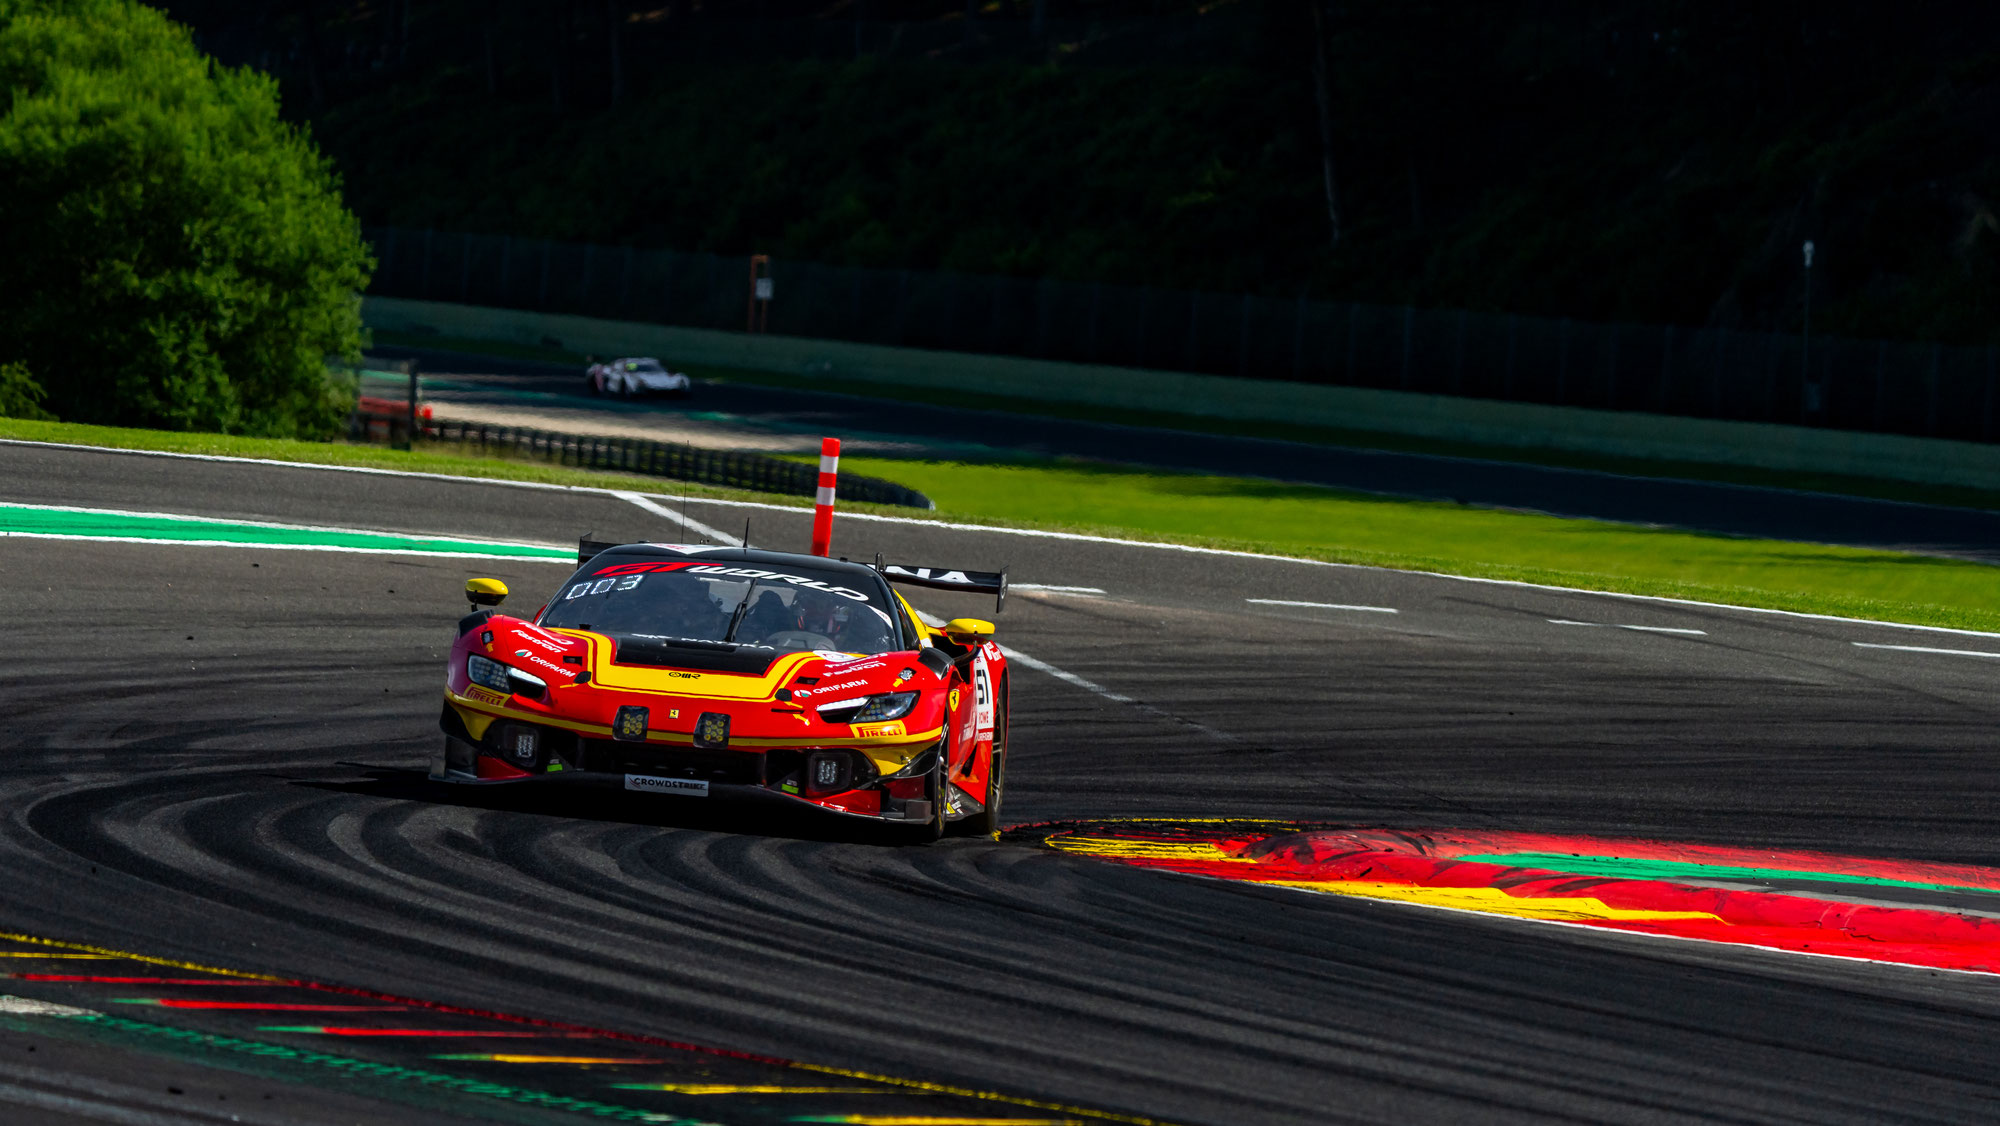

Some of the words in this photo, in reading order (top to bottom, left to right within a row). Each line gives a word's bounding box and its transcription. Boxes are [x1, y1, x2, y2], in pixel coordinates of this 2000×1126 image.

[565, 574, 644, 600] 003
[592, 561, 723, 577] GT
[685, 565, 870, 602] WORLD
[530, 656, 576, 678] ORIFARM
[468, 686, 505, 706] PIRELLI
[813, 679, 868, 694] ORIFARM
[976, 669, 989, 705] 51
[856, 724, 902, 738] PIRELLI
[634, 777, 707, 791] CROWDSTRIKE
